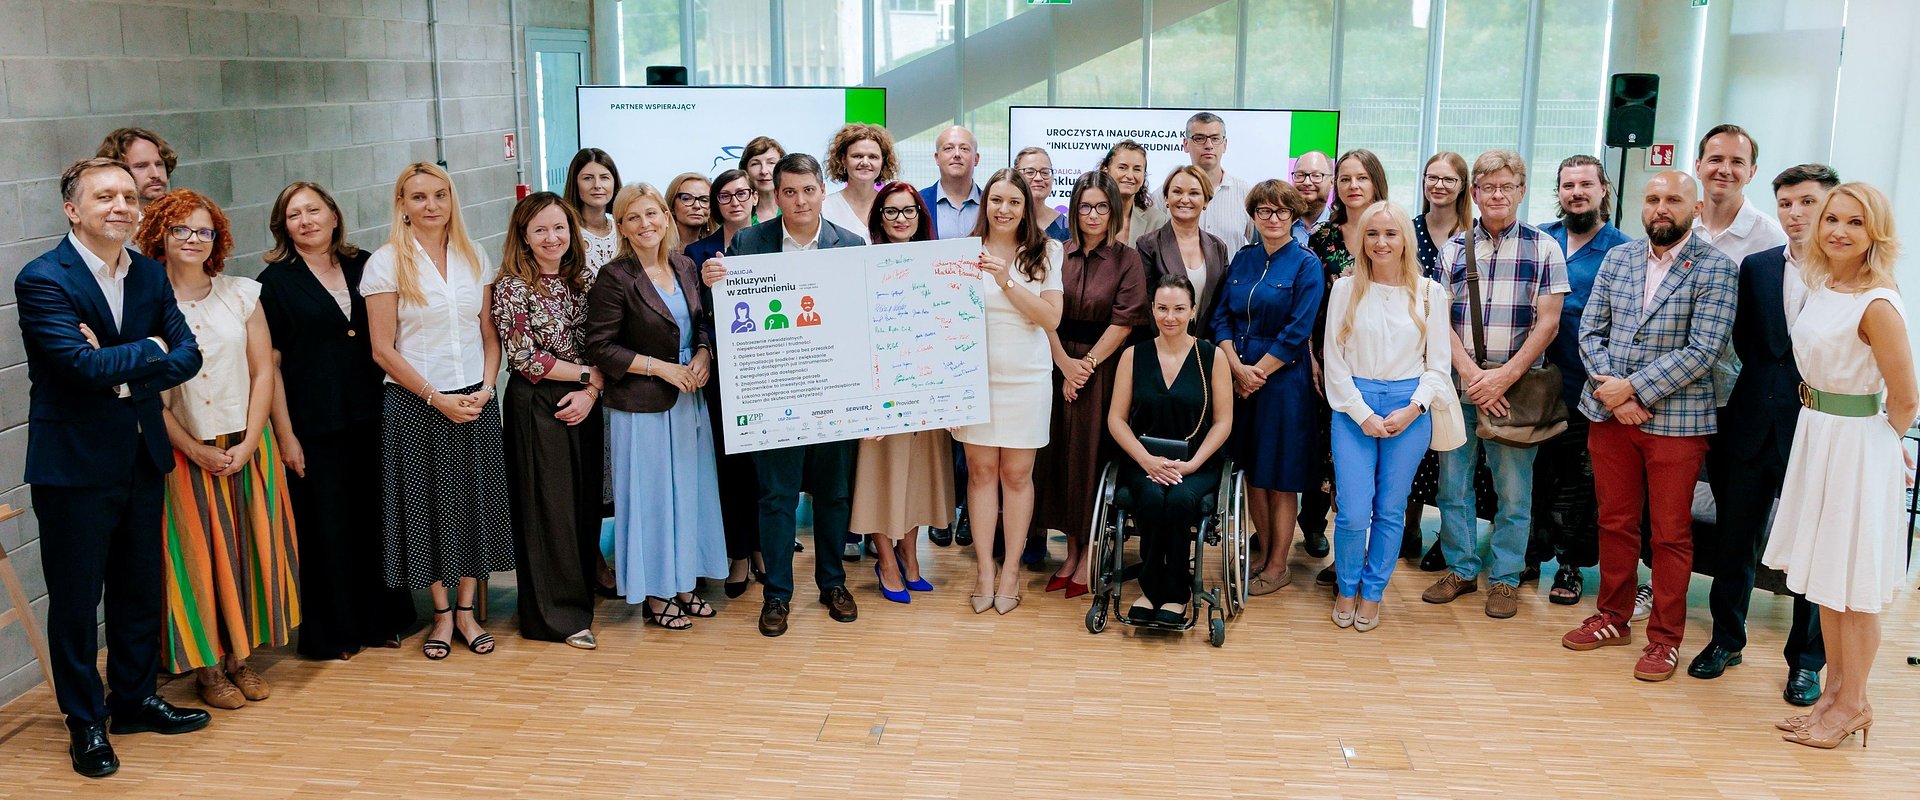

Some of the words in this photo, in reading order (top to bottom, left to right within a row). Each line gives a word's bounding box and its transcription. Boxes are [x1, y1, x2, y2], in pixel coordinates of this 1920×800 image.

[645, 103, 696, 111] WSPIERAJĄCY
[1046, 128, 1104, 136] UROCZYSTA
[1106, 130, 1177, 138] INAUGURACJA
[726, 274, 776, 286] Inkluzywni
[737, 283, 796, 296] zatrudnieniu
[749, 413, 763, 421] ZPP
